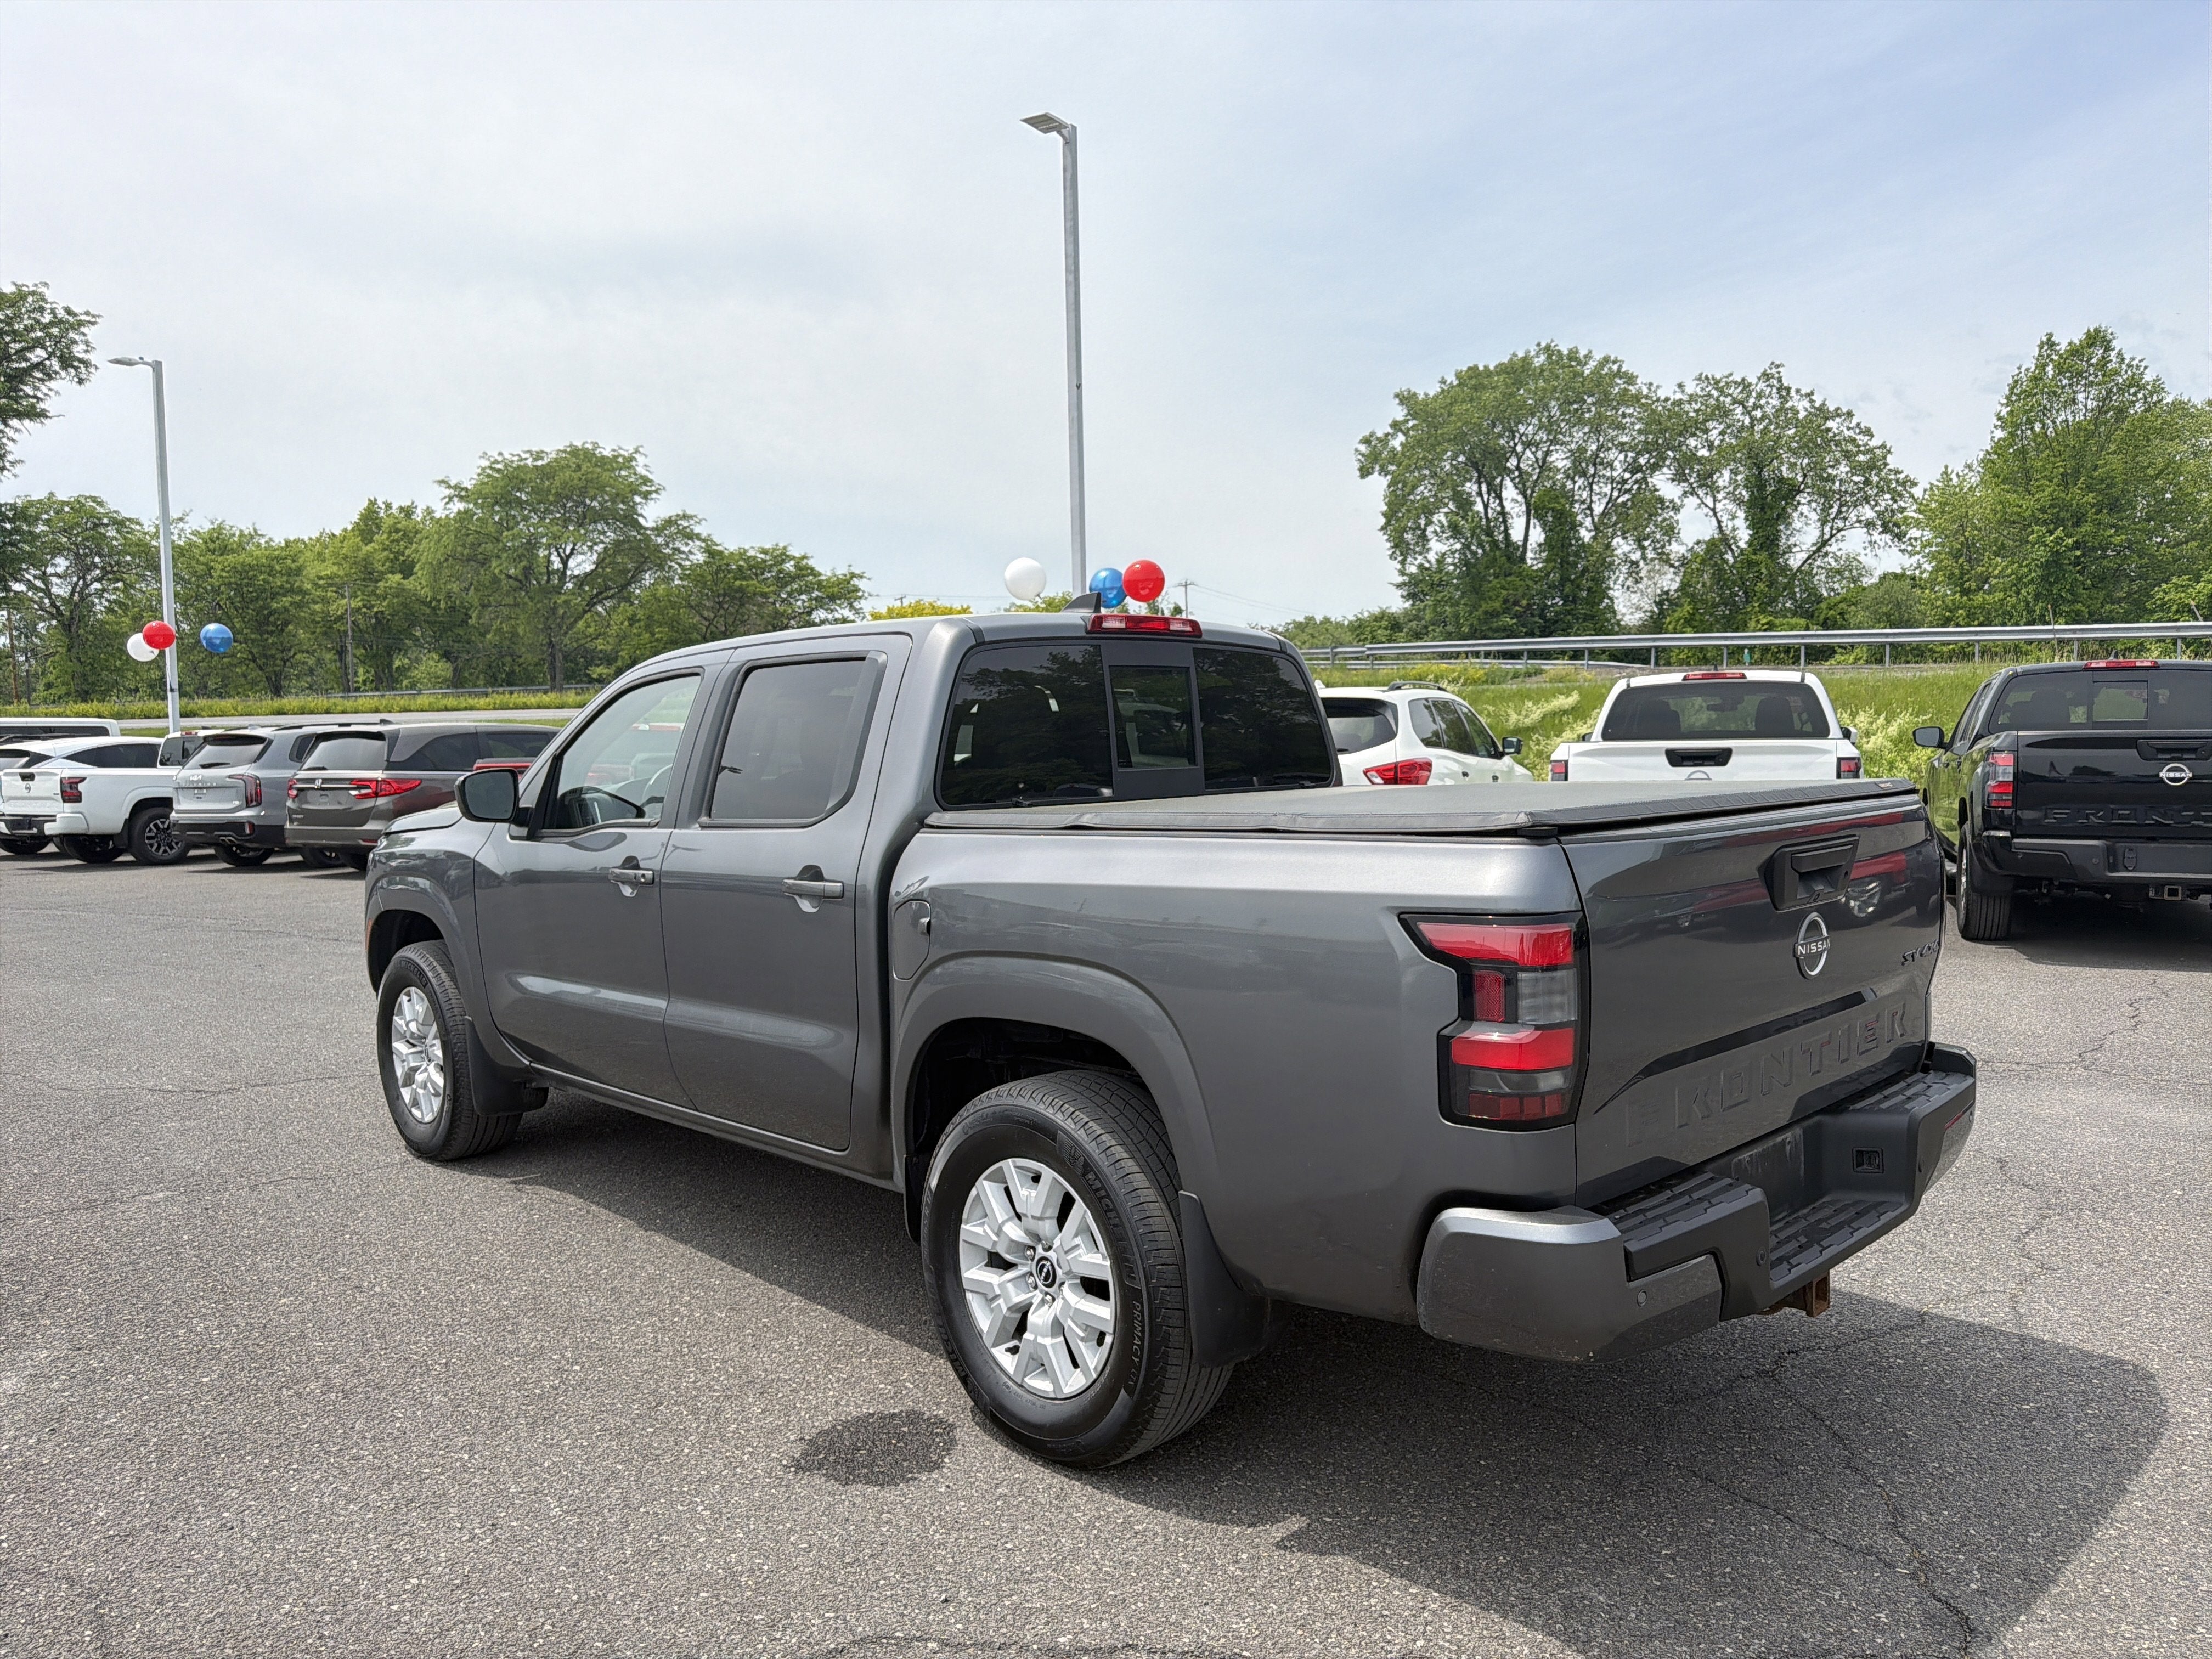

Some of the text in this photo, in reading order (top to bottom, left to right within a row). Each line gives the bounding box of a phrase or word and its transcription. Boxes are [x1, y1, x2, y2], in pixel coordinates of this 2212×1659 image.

[1798, 938, 1831, 955] NISSAN
[1625, 1001, 1906, 1148] FRONTIER
[1132, 1301, 1142, 1366] PRIMACY
